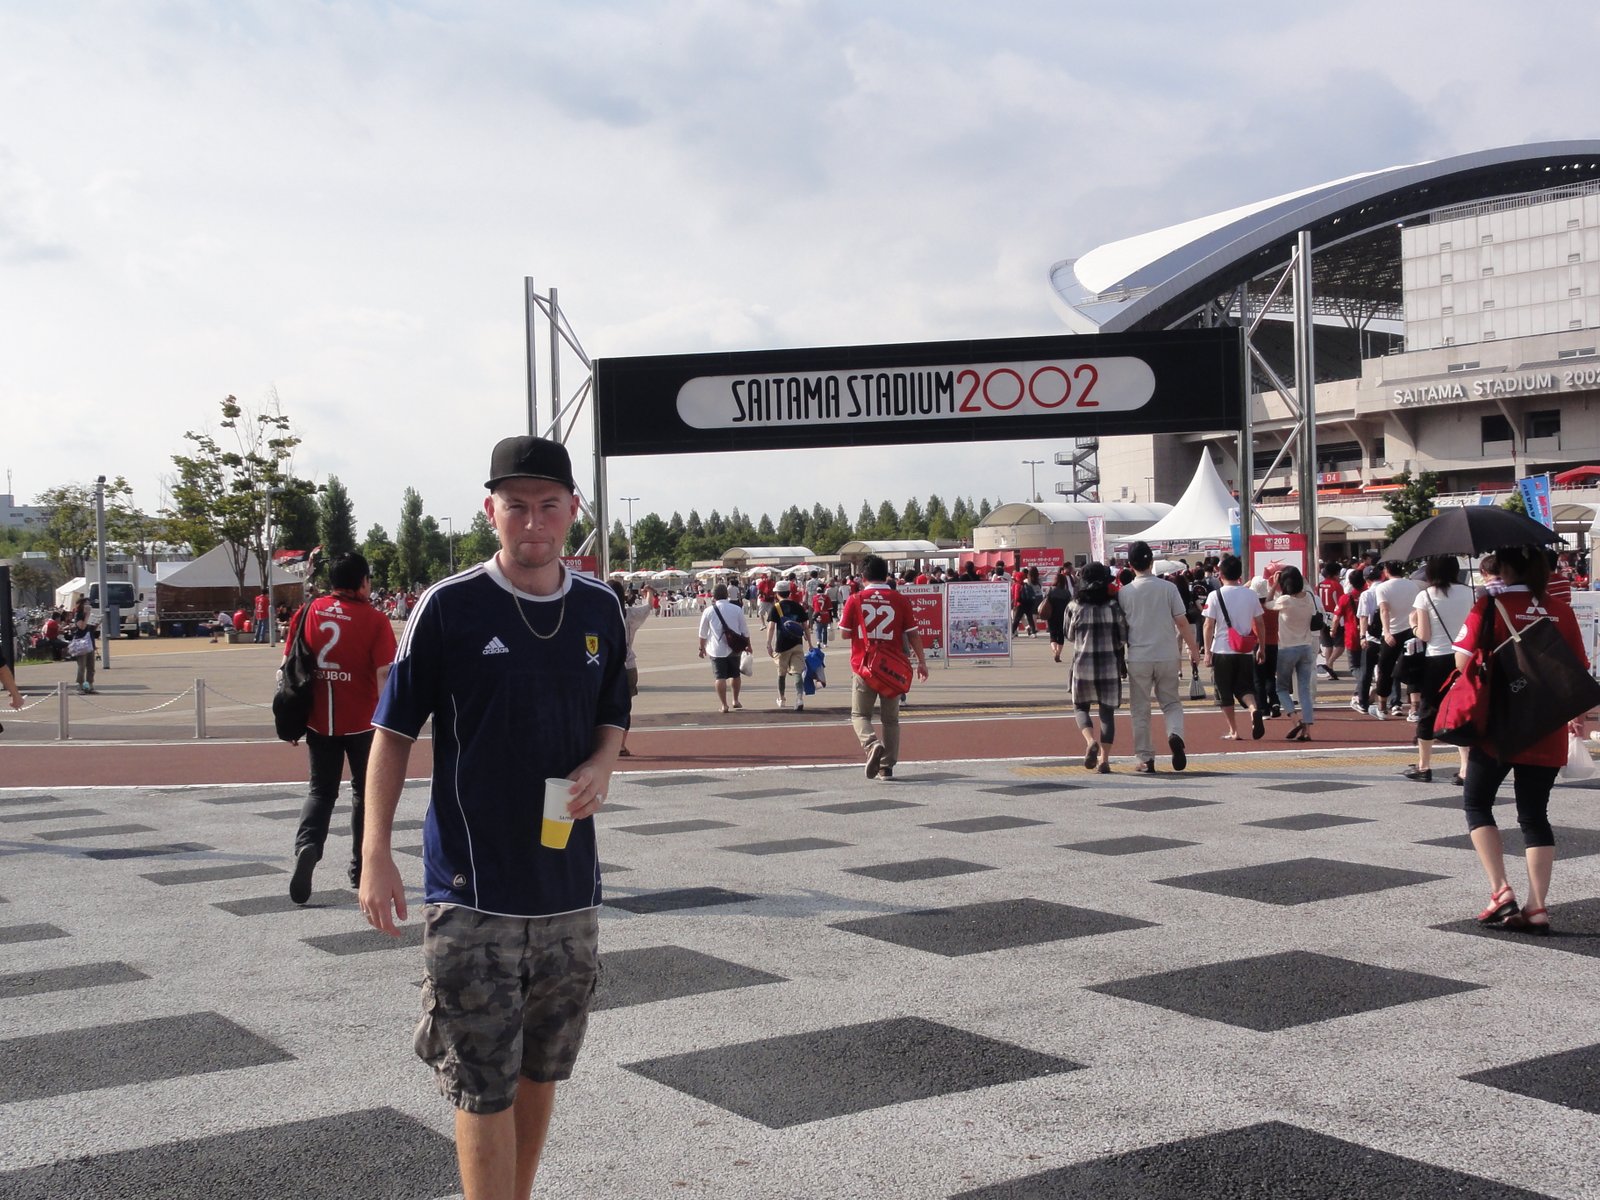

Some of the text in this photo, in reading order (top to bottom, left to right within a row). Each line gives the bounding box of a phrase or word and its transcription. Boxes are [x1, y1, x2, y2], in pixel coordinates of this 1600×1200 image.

[731, 364, 1100, 422] SAITAMA STADIUM 2002
[1393, 383, 1464, 404] SAITAMA
[1473, 372, 1552, 397] STADIUM
[1273, 537, 1290, 545] 2010
[916, 597, 937, 607] Shop
[858, 604, 895, 640] 22
[926, 628, 941, 636] Bar
[316, 620, 341, 670] 2
[482, 647, 509, 655] adidas
[314, 670, 352, 682] SUBOI
